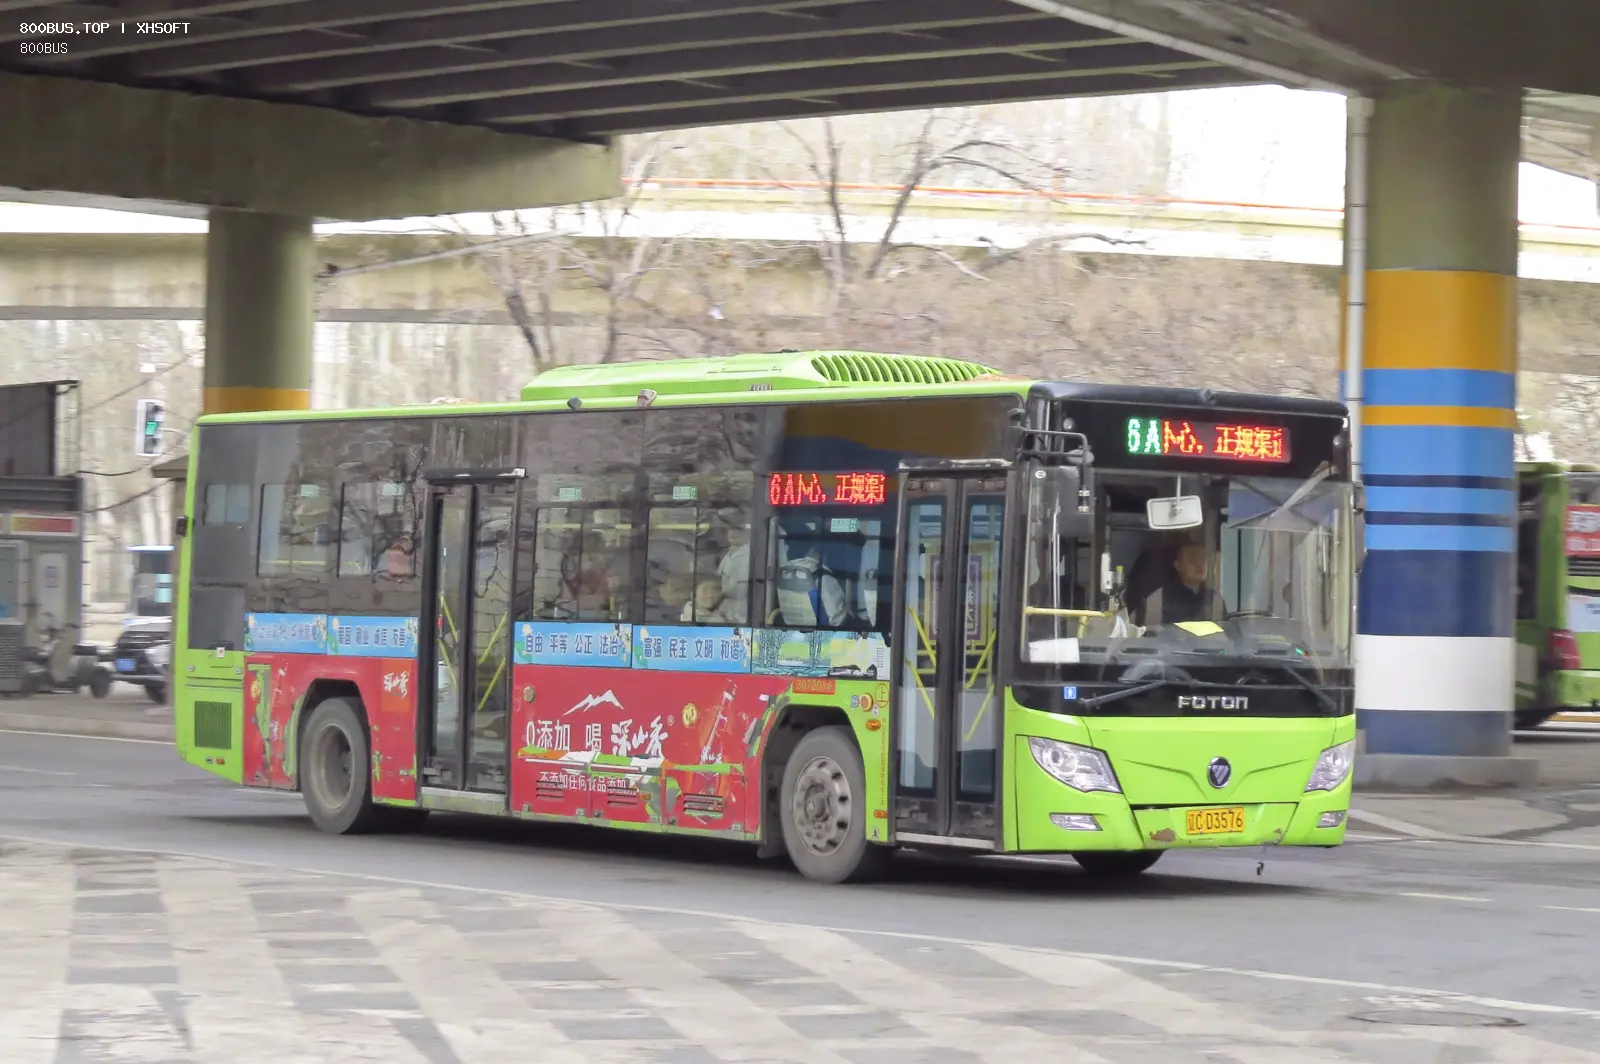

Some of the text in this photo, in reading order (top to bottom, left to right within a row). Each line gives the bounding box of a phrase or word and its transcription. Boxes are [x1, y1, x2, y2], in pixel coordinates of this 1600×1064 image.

[525, 633, 619, 656] 自由 平等 公正 法治
[643, 637, 739, 660] 富强 民主 文明 和谐
[1177, 695, 1249, 709] FOTON
[585, 723, 603, 752] 喝
